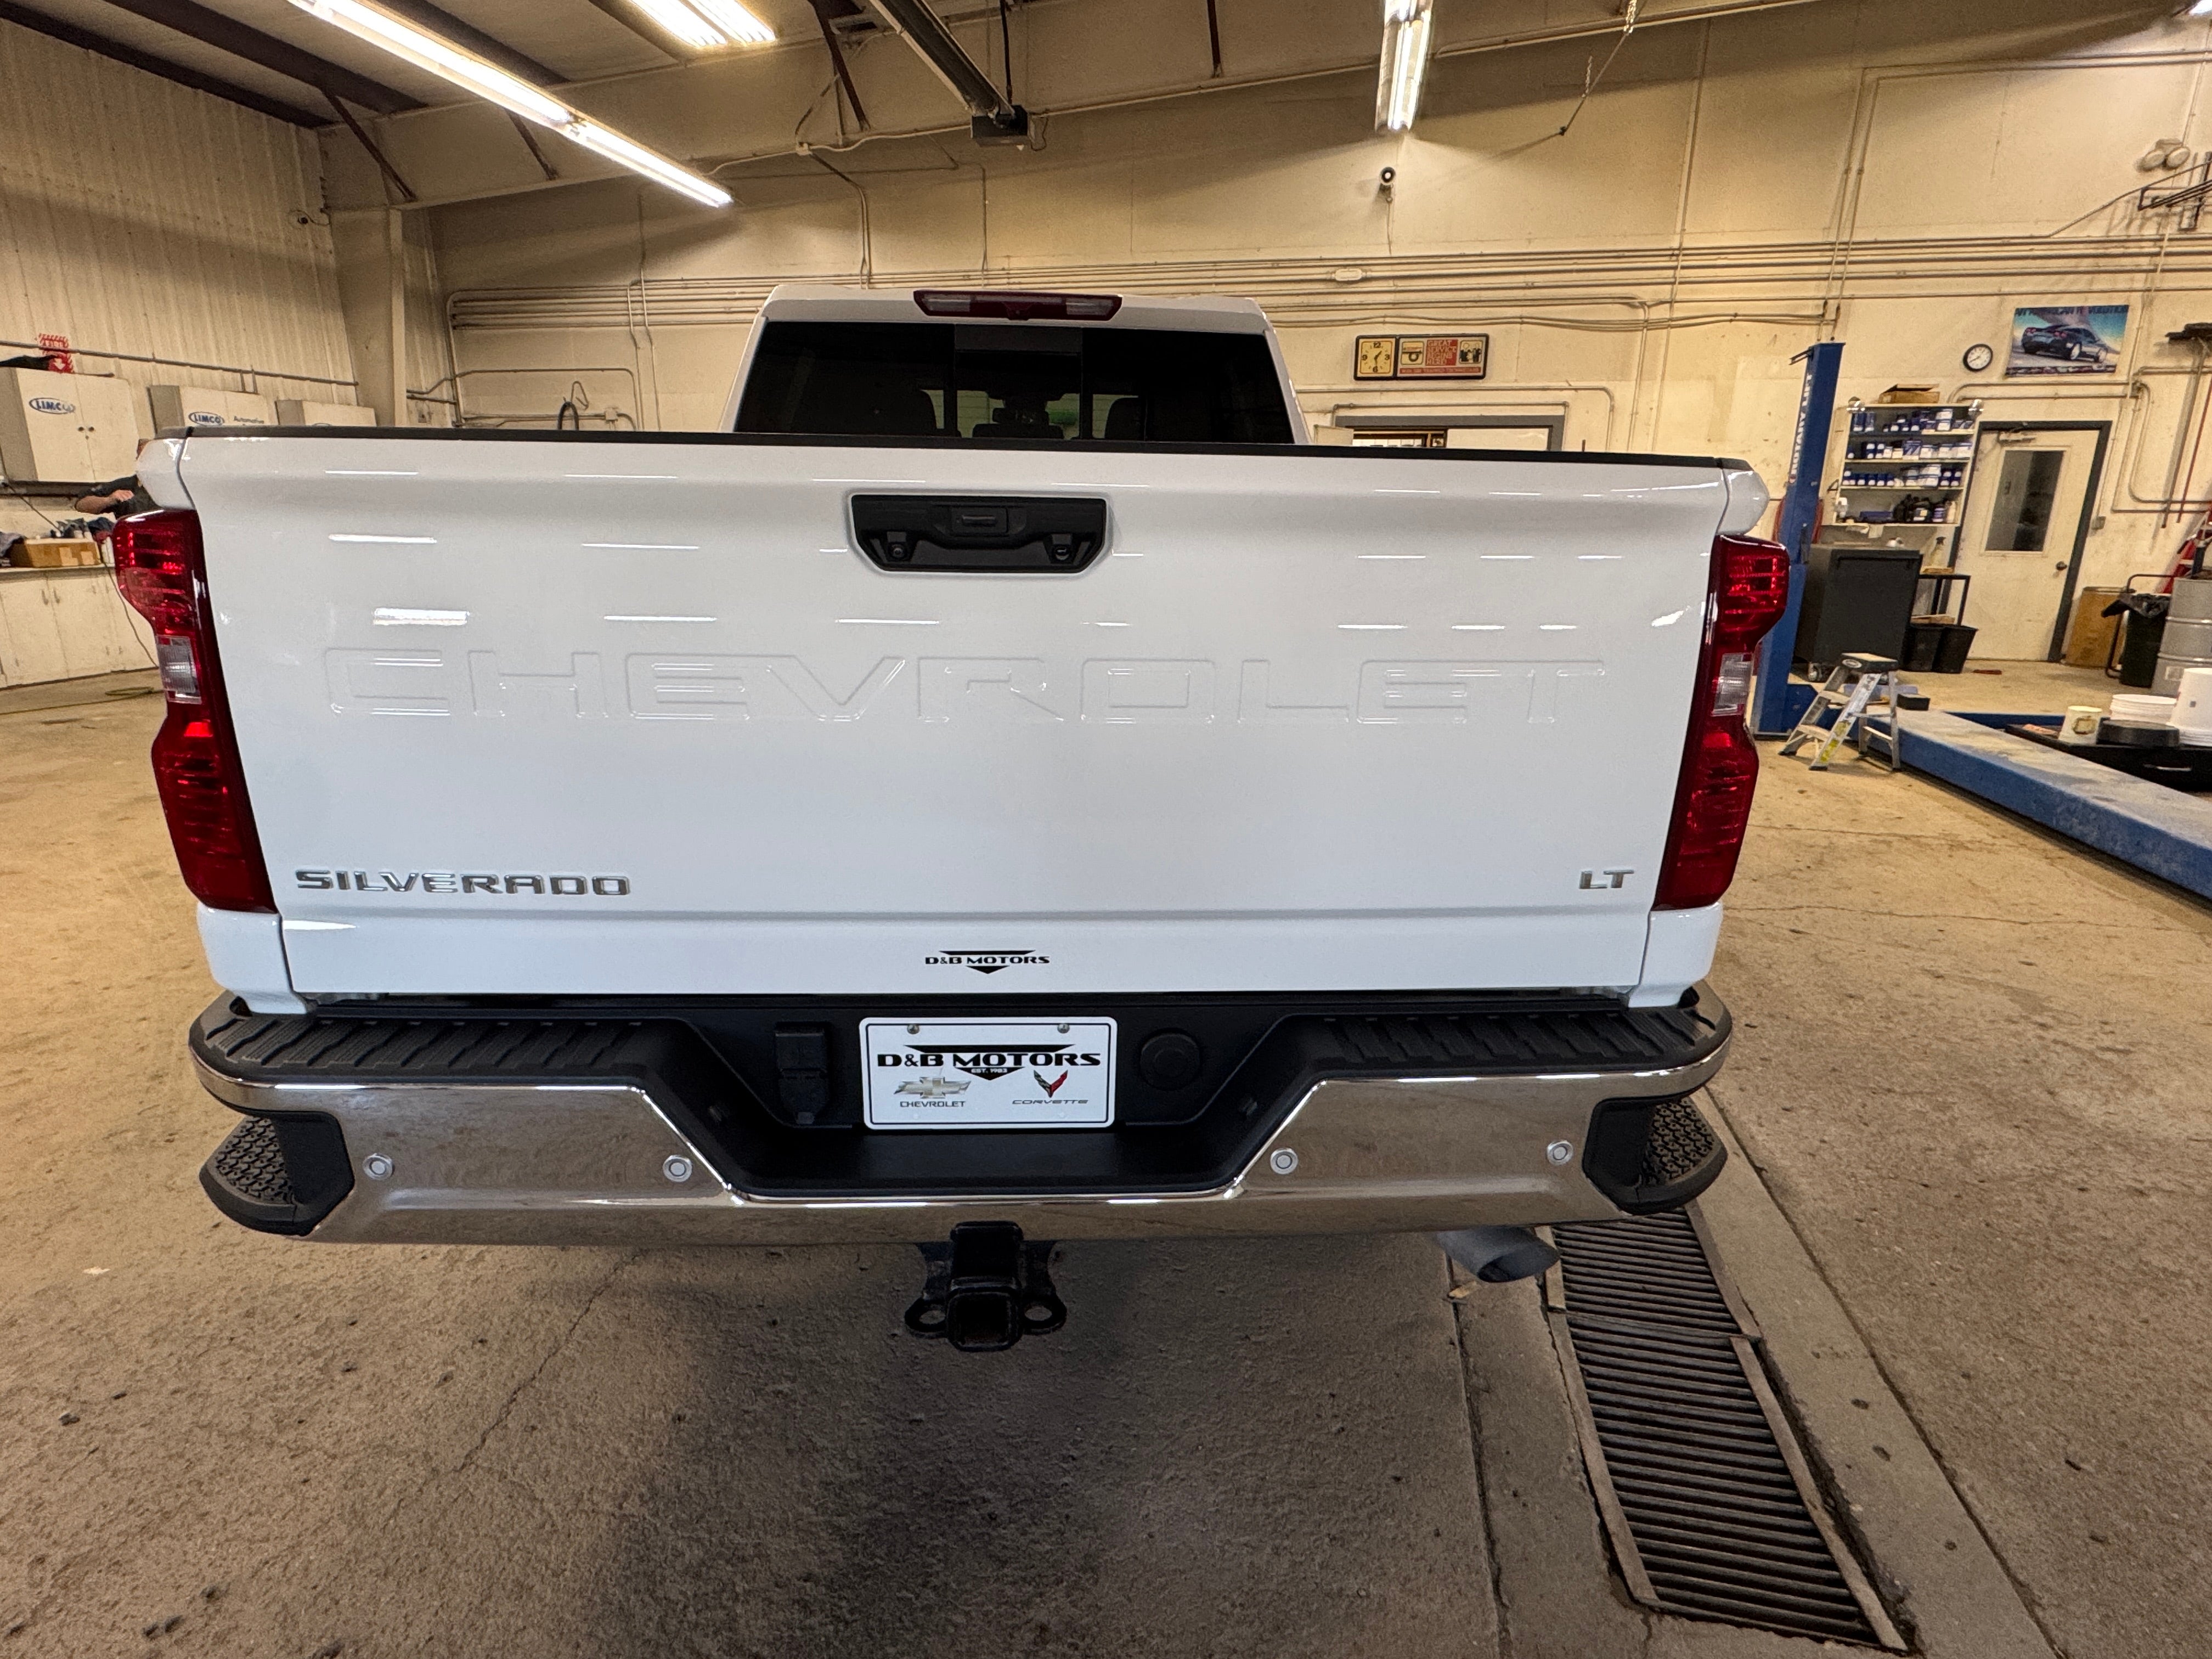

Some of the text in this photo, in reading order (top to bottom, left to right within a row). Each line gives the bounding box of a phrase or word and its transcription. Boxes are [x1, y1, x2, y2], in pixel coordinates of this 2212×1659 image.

[194, 414, 220, 424] LIMCO
[325, 647, 1605, 723] CHEVROLET
[295, 869, 631, 895] SILVERADO
[1579, 869, 1635, 889] LT
[925, 956, 1050, 964] D&B MOTORS
[878, 1052, 1101, 1067] D&B MOTORS
